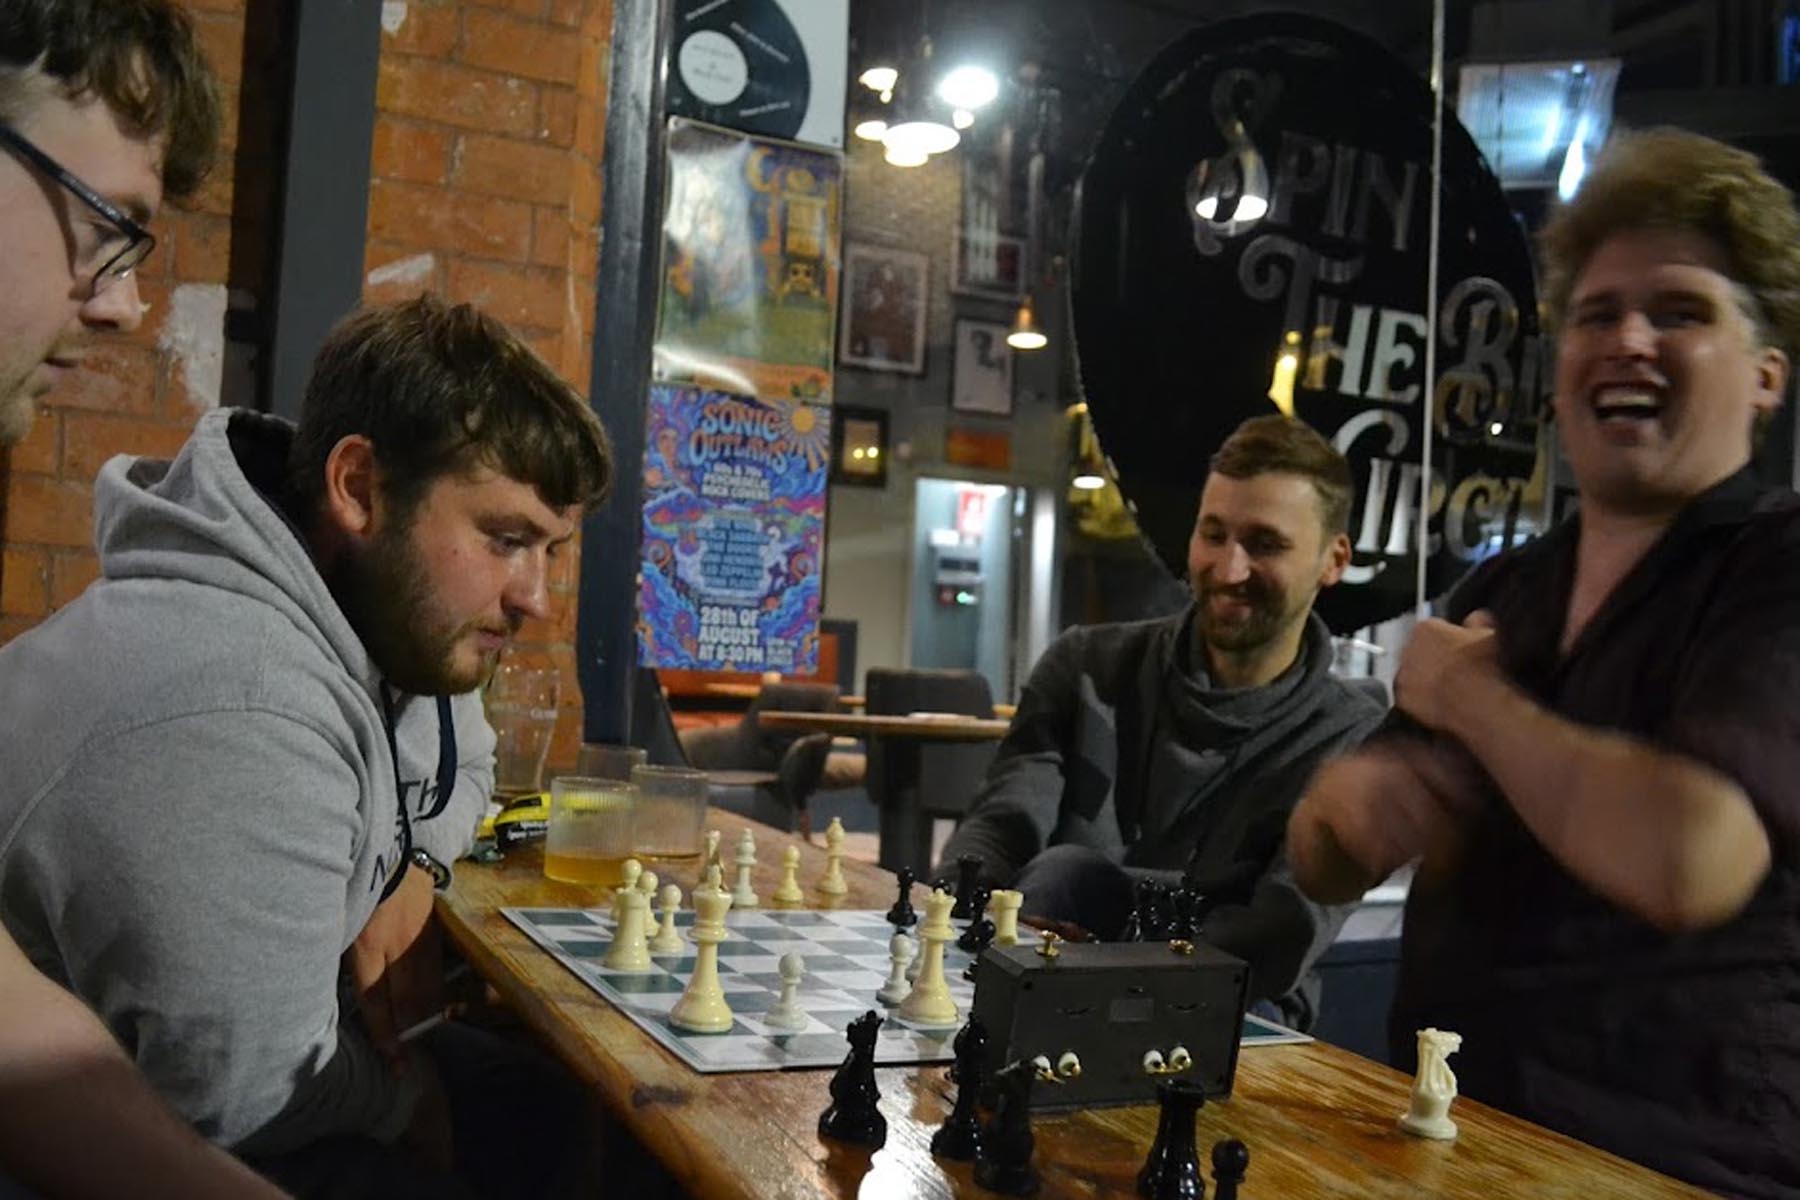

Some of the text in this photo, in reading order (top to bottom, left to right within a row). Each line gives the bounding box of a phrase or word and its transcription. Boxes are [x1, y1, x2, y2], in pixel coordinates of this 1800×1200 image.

[1186, 67, 1420, 256] SPIN
[1238, 233, 1428, 416] THE
[702, 401, 780, 441] SONIC
[700, 606, 759, 628] 28th OF
[698, 625, 760, 646] AUGUST
[698, 644, 714, 661] AT
